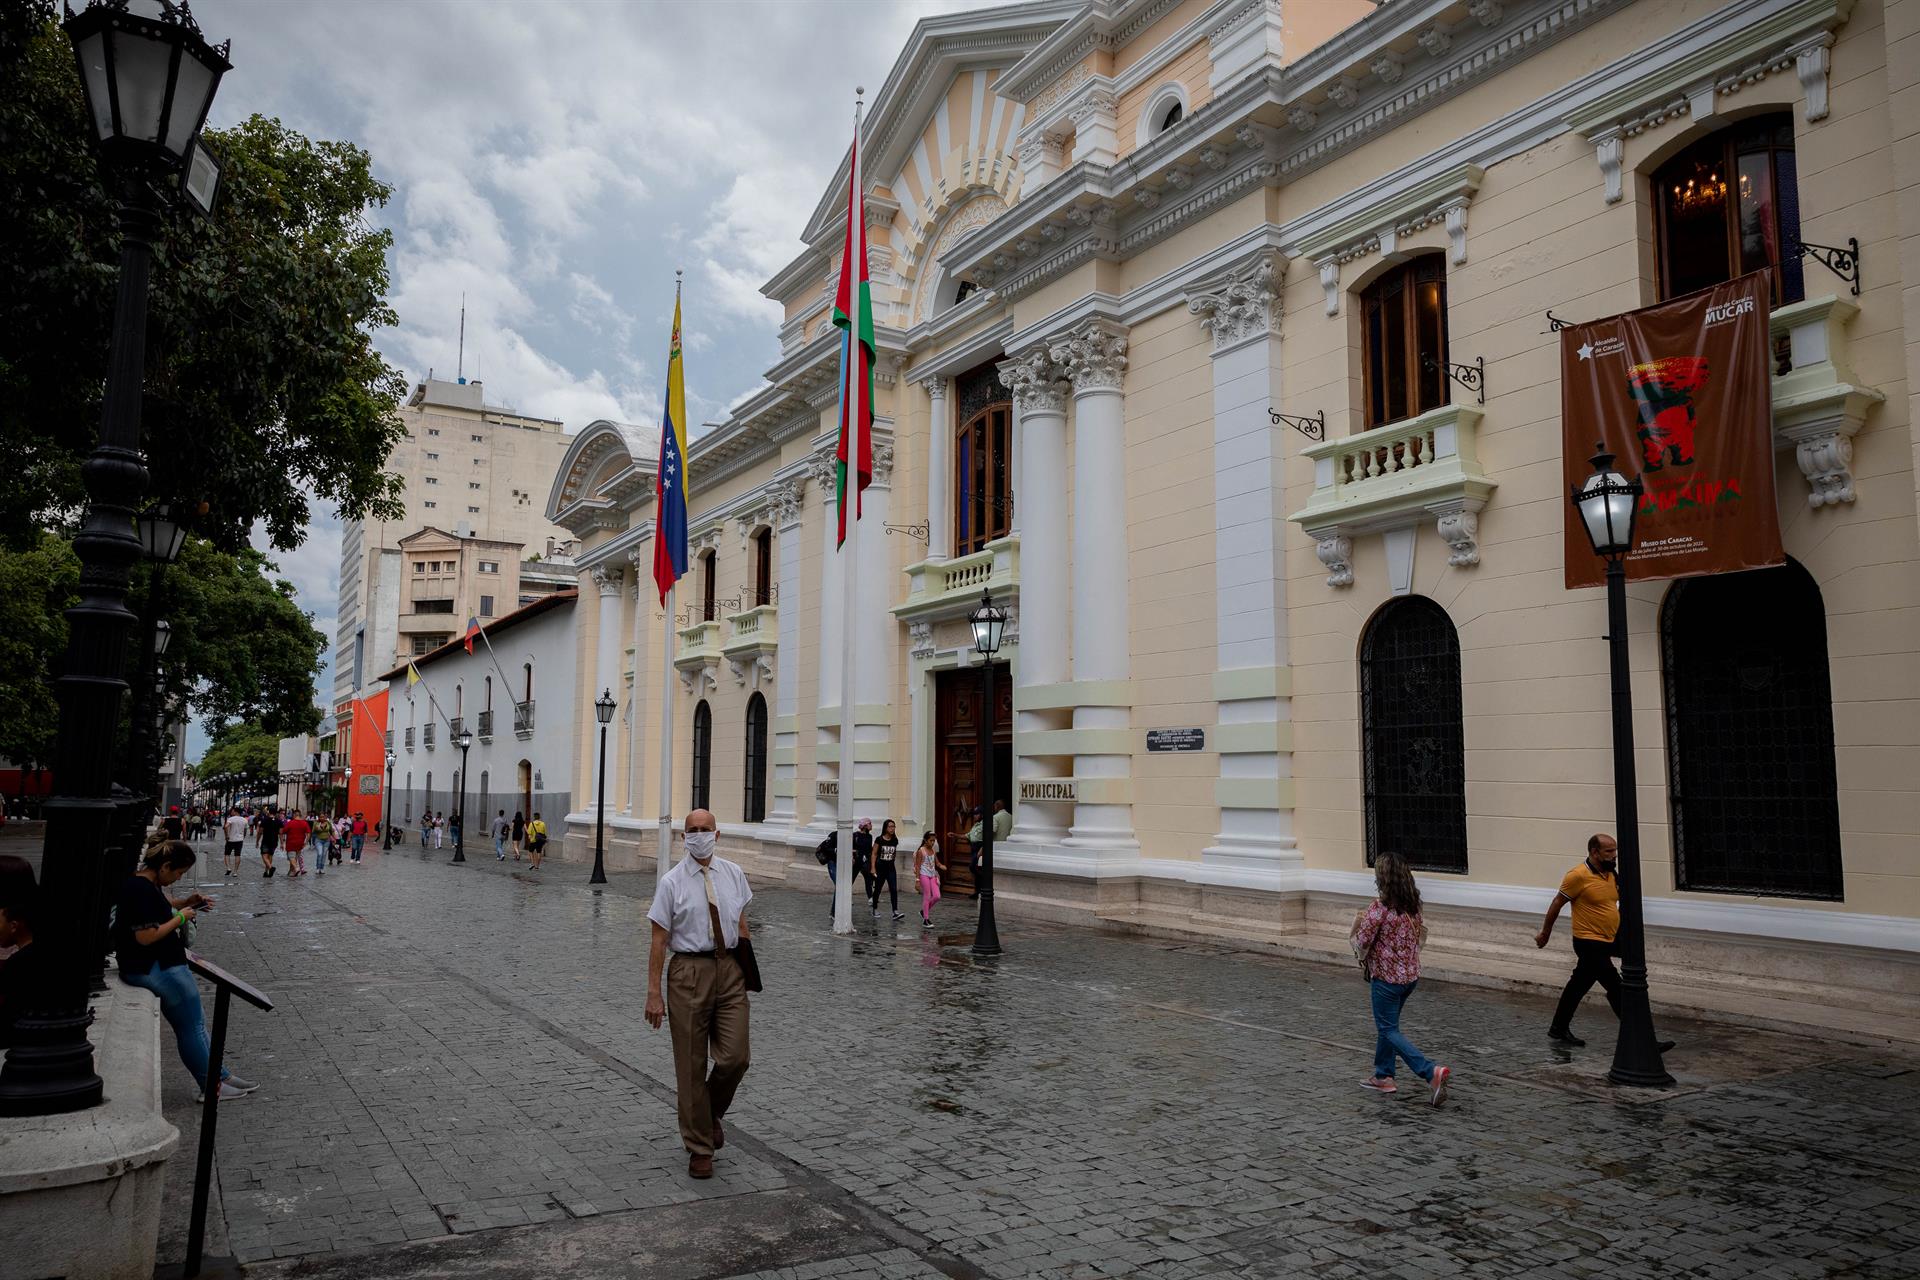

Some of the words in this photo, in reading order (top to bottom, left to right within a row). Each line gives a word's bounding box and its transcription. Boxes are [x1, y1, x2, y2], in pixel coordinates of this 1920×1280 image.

[1705, 301, 1754, 325] MUCAR
[819, 783, 839, 795] CONCE
[1021, 783, 1075, 799] MUNICIPAL
